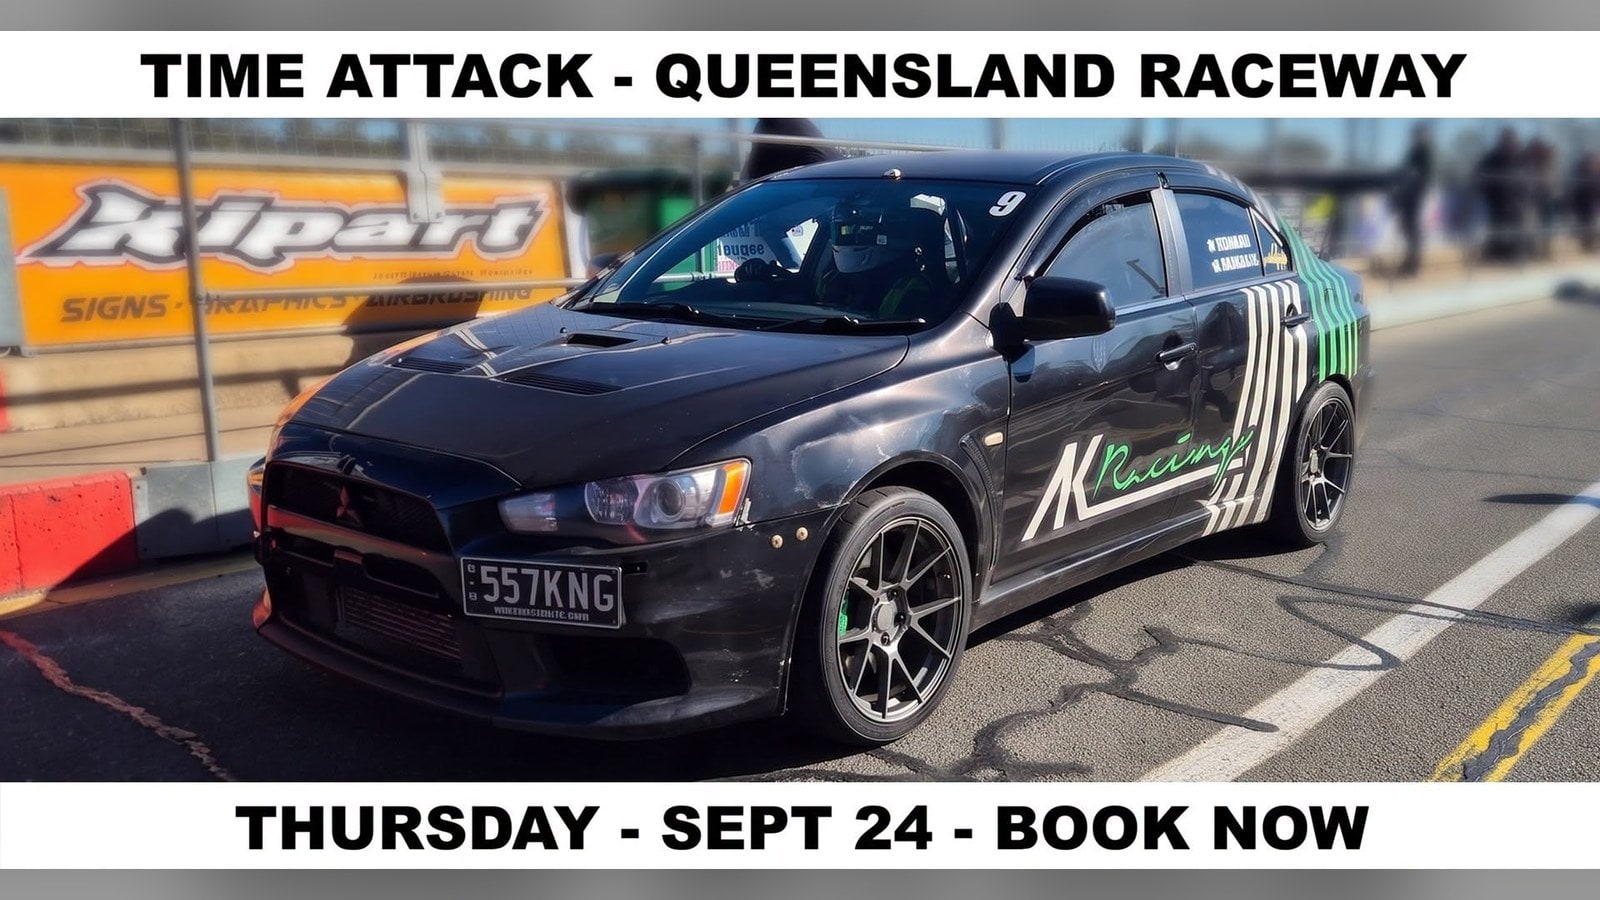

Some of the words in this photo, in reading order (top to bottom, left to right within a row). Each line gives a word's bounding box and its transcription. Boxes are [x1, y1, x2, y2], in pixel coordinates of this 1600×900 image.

[989, 191, 1027, 217] 9
[60, 294, 169, 323] SIGNS
[480, 565, 614, 612] 557KNG
